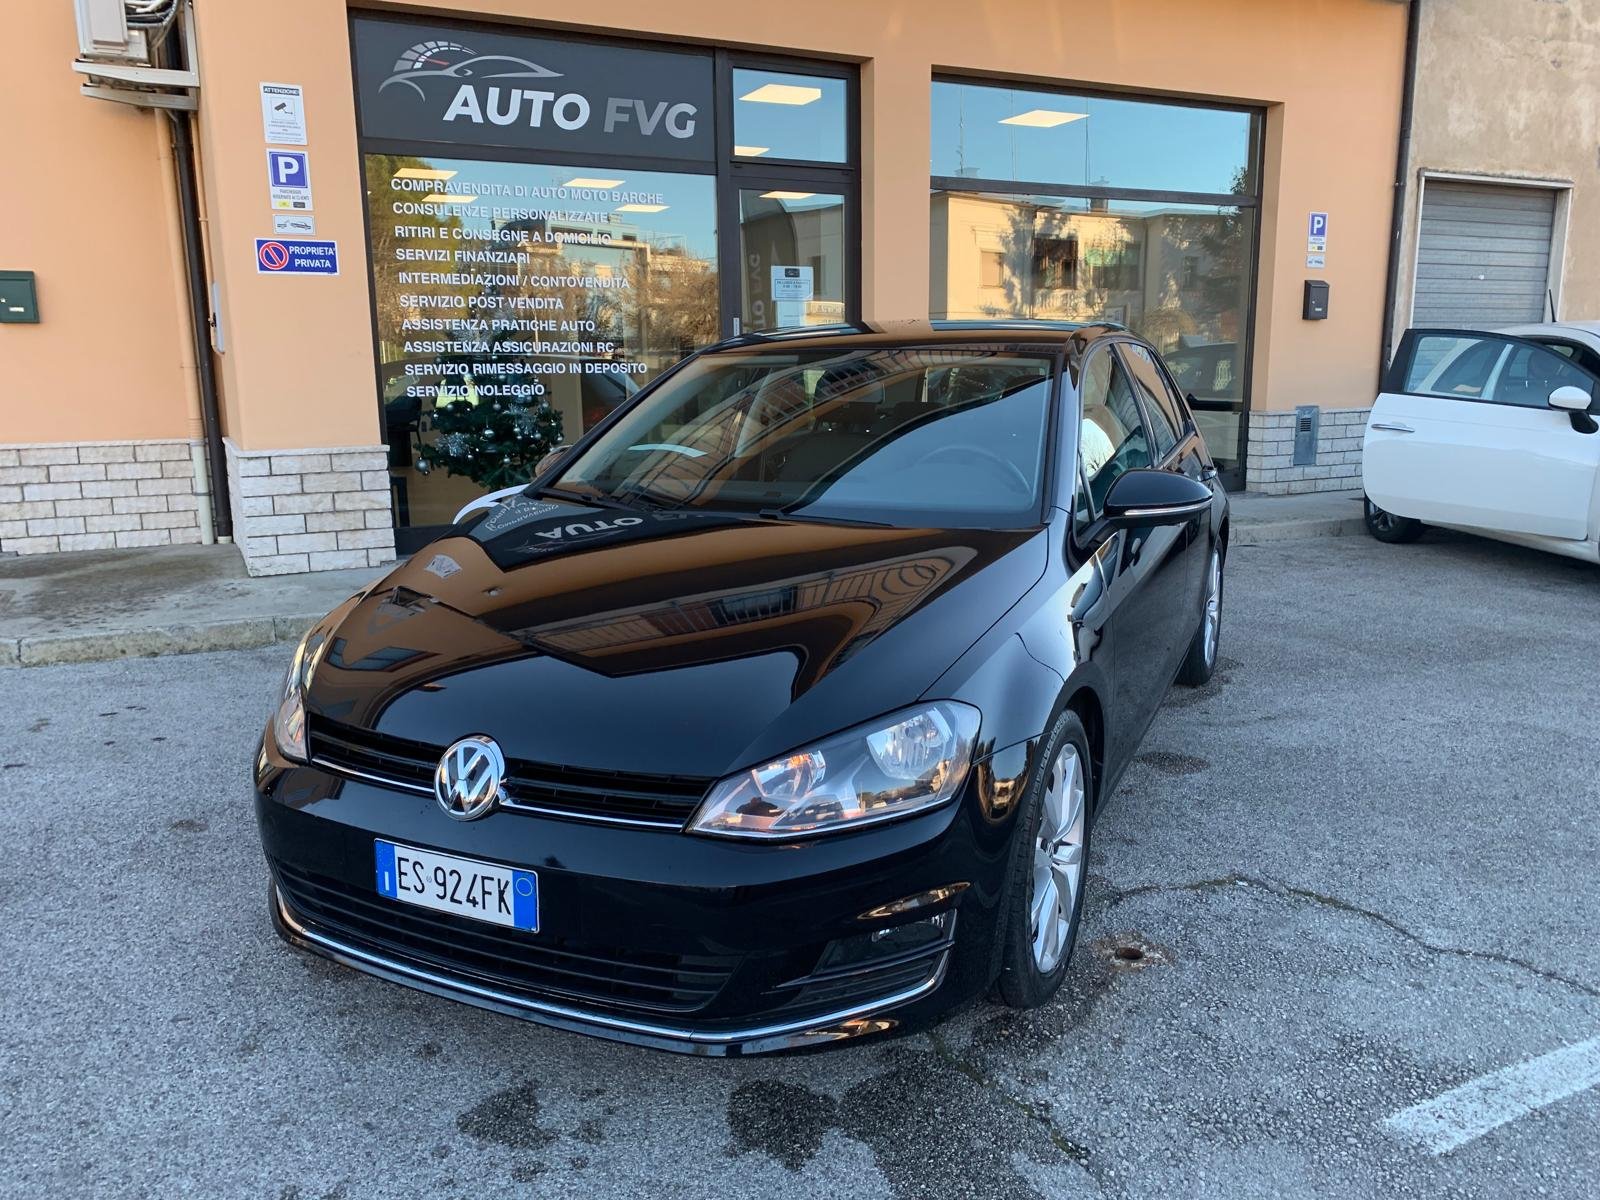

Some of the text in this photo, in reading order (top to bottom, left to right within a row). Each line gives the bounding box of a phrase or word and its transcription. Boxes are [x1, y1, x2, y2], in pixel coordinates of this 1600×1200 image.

[443, 84, 698, 139] AUTO FVG
[278, 156, 299, 183] P
[391, 178, 663, 204] COMPRAVENDITA DI AUTO MOTO BARCHE
[393, 203, 608, 223] CONSULENZE PERSONALIZZATE
[1313, 216, 1324, 234] P
[395, 226, 611, 245] RITIRI E CONSEGNE A DOMICILIO
[295, 258, 332, 268] PRIVATA
[396, 249, 530, 264] SERVIZI FINANZIARI
[399, 272, 629, 289] INTERMEDIAZIONI / CONTOVENDITA
[400, 296, 563, 310] SERVIZIO POST VENDITA
[402, 320, 595, 332] ASSISTENZA PRATICHE AUTO
[404, 342, 614, 354] ASSISTENZA ASSICURAZIONI RC
[405, 363, 647, 375] SERVIZIO RIMESSAGGIO IN DEPOSITO
[407, 384, 545, 397] SERVIZIO NOLEGGIO
[433, 866, 512, 916] 924FK
